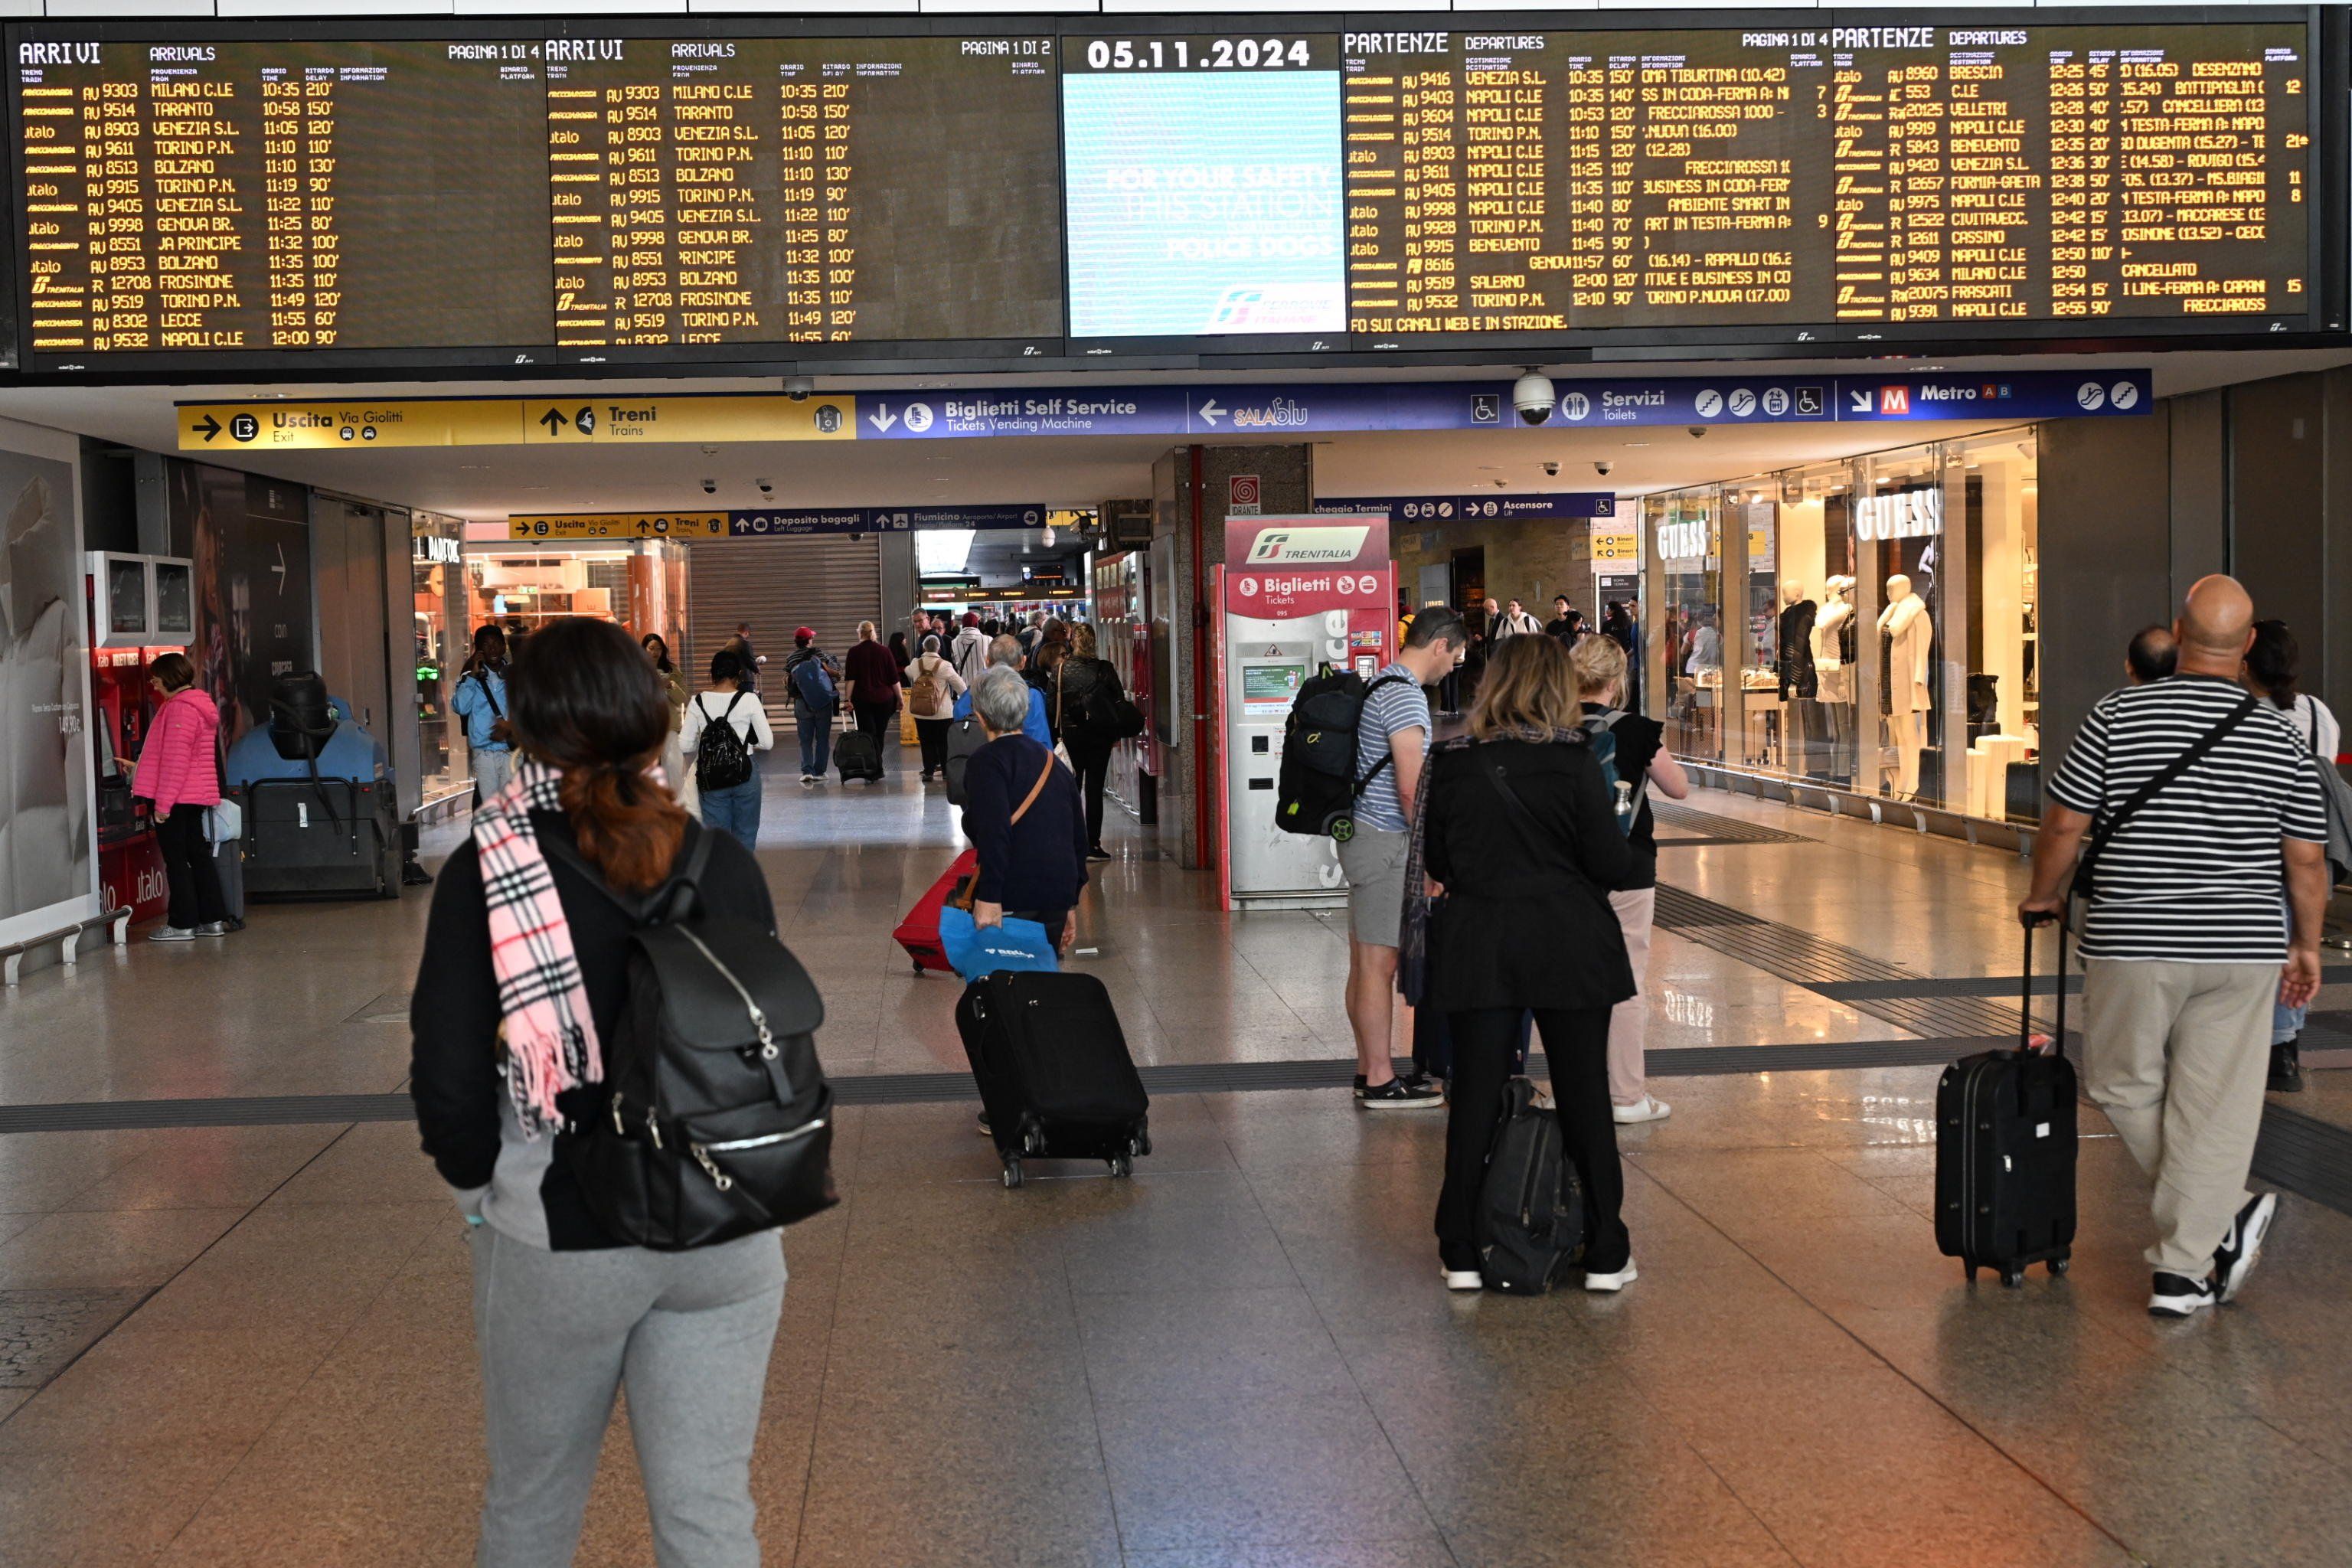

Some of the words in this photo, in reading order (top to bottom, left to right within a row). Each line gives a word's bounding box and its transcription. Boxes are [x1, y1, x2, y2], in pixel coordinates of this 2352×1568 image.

[1344, 32, 1449, 54] PARTENZE
[1465, 35, 1544, 50] DEPARTURES
[1742, 33, 1789, 47] PAGINA
[1792, 33, 1798, 47] 1
[1801, 32, 1815, 47] DI
[1818, 32, 1828, 46] 4
[1832, 27, 1934, 48] PARTENZE
[1949, 31, 2027, 45] DEPARTURES
[149, 47, 216, 61] ARRIVALS
[448, 44, 498, 60] PAGINA
[501, 45, 508, 59] 1
[511, 44, 526, 59] DI
[531, 45, 540, 59] 4
[671, 43, 735, 57] ARRIVALS
[962, 41, 1009, 55] PAGINA
[1013, 41, 1019, 54] 1
[1023, 41, 1037, 54] DI
[1041, 40, 1050, 54] 2
[1087, 38, 1310, 69] 05.11.2024
[1402, 75, 1418, 90] AV
[1419, 71, 1451, 87] 9416
[1465, 70, 1520, 86] VENEZIA
[1522, 70, 1547, 85] S.L.
[1568, 70, 1604, 85] 10:35
[1669, 67, 1738, 83] TIBURTINA
[1740, 67, 1786, 83] (10.42)
[83, 87, 100, 101] AV
[102, 83, 139, 98] 9303
[151, 83, 201, 97] MILANO
[204, 82, 234, 97] C.LE
[262, 82, 300, 96] 10:35
[1648, 104, 1742, 121] FRECCIAROSSA
[1743, 104, 1774, 119] 1000
[1817, 103, 1828, 119] 3
[1949, 101, 2008, 117] VELLETRI
[2050, 100, 2085, 116] 12:28
[608, 131, 624, 145] AV
[627, 126, 662, 142] 8903
[674, 126, 730, 141] VENEZIA
[733, 126, 759, 140] S.L.
[782, 125, 815, 140] 11:05
[609, 172, 626, 186] AV
[629, 168, 660, 183] 8513
[675, 167, 734, 182] BOLZANO
[783, 166, 814, 181] 11:10
[1106, 169, 1155, 189] FOR
[1161, 168, 1230, 188] YOUR
[1242, 166, 1330, 186] SAFETY
[1124, 194, 1190, 220] THIS
[1199, 192, 1331, 218] STATION
[1668, 197, 1729, 212] AMBIENTE
[1731, 196, 1772, 211] SMART
[1775, 196, 1791, 211] IN
[1907, 230, 1940, 246] 12611
[1951, 230, 2005, 245] CASSINO
[2050, 228, 2086, 243] 12:42
[1166, 237, 1253, 257] POLICE
[1259, 237, 1333, 256] DOGS
[1405, 242, 1422, 257] AV
[1423, 239, 1455, 253] 9915
[1468, 237, 1540, 253] BENEVENTO
[1571, 237, 1605, 251] 11:45
[1907, 267, 1941, 282] 9634
[1952, 266, 1996, 281] MILANO
[1999, 266, 2027, 280] C.LE
[2051, 265, 2086, 279] 12:50
[2121, 263, 2197, 278] CANCELLATO
[2287, 278, 2301, 292] 15
[632, 292, 673, 307] 12708
[680, 291, 753, 306] FROSINONE
[787, 289, 821, 305] 11:35
[93, 317, 109, 332] AV
[113, 313, 148, 328] 8302
[161, 312, 203, 328] LECCE
[271, 311, 306, 326] 11:55
[1370, 318, 1393, 332] SUI
[1396, 317, 1442, 332] CANALI
[1444, 316, 1470, 332] WEB
[1472, 316, 1481, 331] E
[1485, 315, 1500, 331] IN
[1501, 314, 1568, 330] STAZIONE.
[1602, 391, 1664, 406] Servizi
[1884, 390, 1906, 410] M
[1921, 385, 1976, 400] Metro
[1986, 387, 1992, 396] A
[2001, 386, 2008, 396] B
[609, 407, 656, 421] Treni
[946, 400, 1019, 419] Biglietti
[1026, 400, 1062, 415] Self
[1067, 399, 1136, 415] Service
[1602, 408, 1636, 420] Toilets
[273, 413, 333, 428] Uscita
[339, 411, 359, 423] Via
[364, 411, 403, 423] Giolitti
[946, 418, 985, 431] Tickets
[990, 418, 1037, 434] Vending
[1042, 417, 1092, 429] Machine
[273, 432, 294, 442] Exit
[609, 424, 643, 436] Trains
[1232, 506, 1259, 514] IDRANTE
[1355, 503, 1392, 513] Termini
[1504, 500, 1553, 510] Ascensore
[675, 518, 699, 527] Treni
[774, 516, 818, 526] Deposito
[821, 514, 860, 525] bagagli
[913, 511, 959, 521] Fiumicino
[1857, 488, 1940, 541] GUESS
[555, 520, 585, 528] Uscita
[1658, 518, 1707, 560] GUESS
[1285, 550, 1351, 558] TRENITALIA
[1265, 577, 1330, 594] Biglietti
[1266, 596, 1294, 604] Tickets
